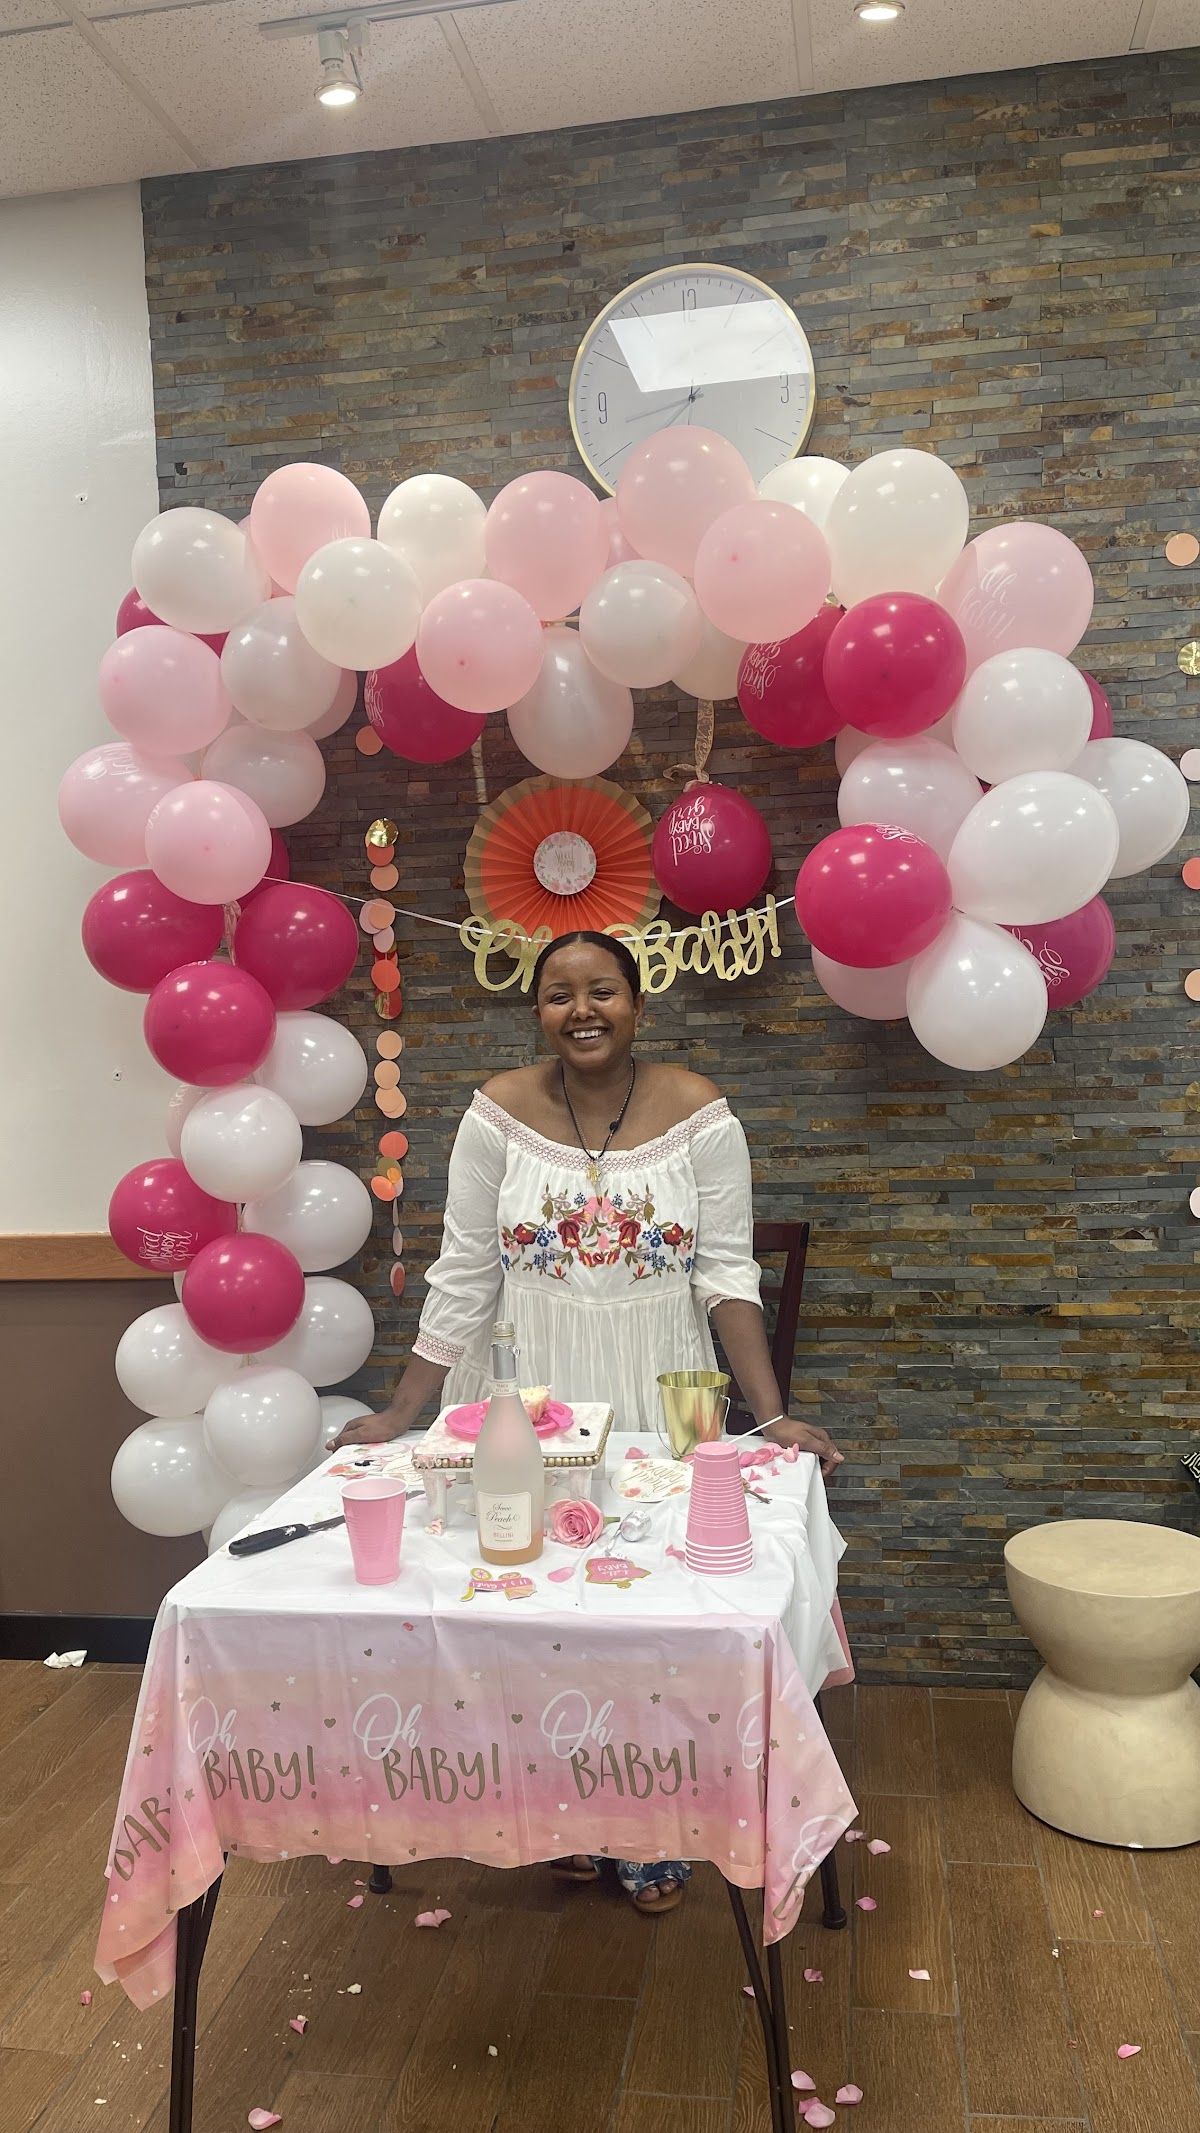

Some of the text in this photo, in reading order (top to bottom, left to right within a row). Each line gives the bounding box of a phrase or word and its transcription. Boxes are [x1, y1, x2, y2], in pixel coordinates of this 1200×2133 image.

[682, 288, 697, 324] 12
[598, 391, 608, 424] 9
[779, 371, 790, 404] 3
[188, 1695, 238, 1771] Oh
[352, 1693, 423, 1761] Oh
[540, 1689, 615, 1760] Oh
[202, 1744, 318, 1803] BABY!
[380, 1742, 502, 1804] BABY!
[569, 1739, 699, 1800] BABY!
